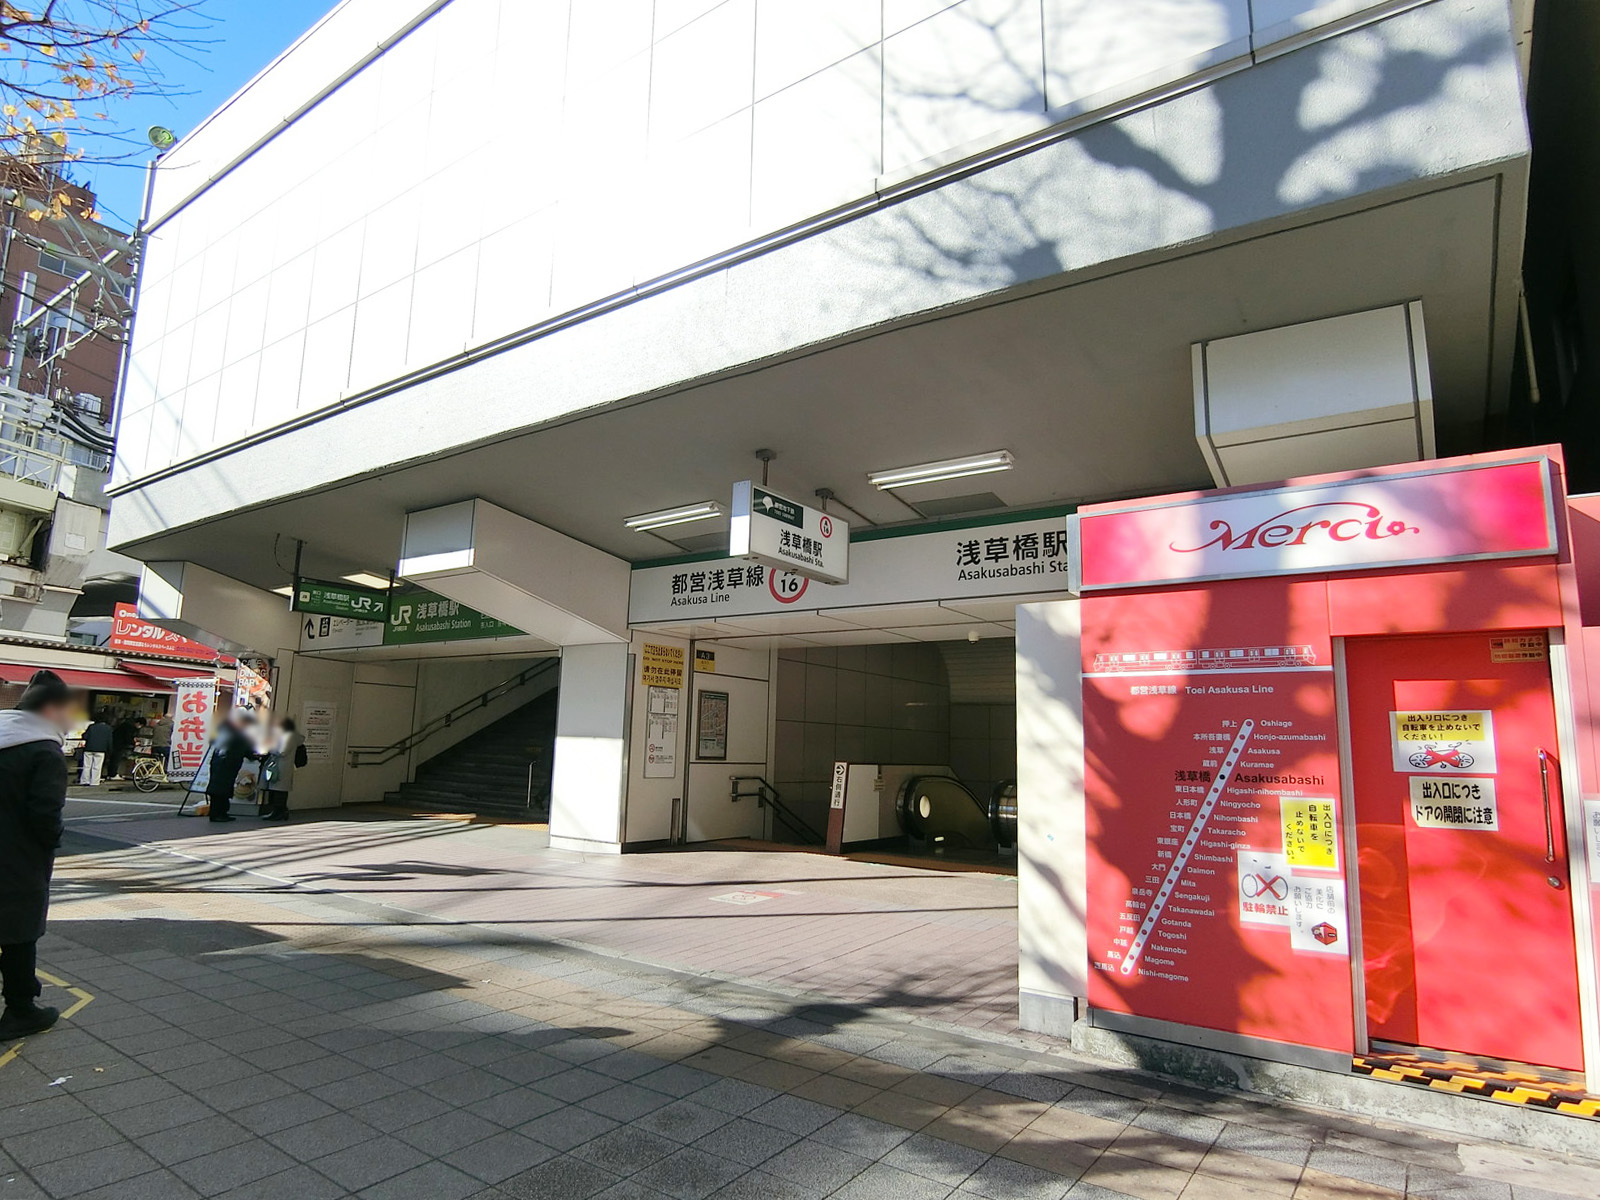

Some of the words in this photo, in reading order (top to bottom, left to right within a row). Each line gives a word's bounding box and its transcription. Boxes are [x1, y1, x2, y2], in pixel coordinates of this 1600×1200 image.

[1169, 502, 1420, 553] Merci
[780, 529, 823, 558] 浅草橋駅
[956, 530, 1067, 567] 浅草橋駅
[778, 546, 814, 565] Asakusabashi
[958, 561, 1045, 582] Asakusabashi
[671, 565, 765, 595] 都営浅草線
[780, 578, 799, 594] 16
[351, 596, 372, 610] JR
[670, 594, 708, 607] Asakusa
[711, 592, 730, 604] Line
[390, 605, 412, 625] JR
[416, 600, 460, 619] 浅草橋駅
[415, 620, 450, 632] Asakusabashi
[451, 618, 471, 629] Station
[1130, 686, 1177, 696] 都営浅草線
[1185, 686, 1205, 695] Toei
[1208, 686, 1250, 694] Asakusa
[1252, 685, 1274, 693] Line
[1406, 713, 1469, 722] 出入り口につき
[177, 690, 208, 768] お弁当
[1222, 720, 1238, 728] 押上
[1260, 719, 1292, 728] Oshiage
[1402, 723, 1481, 732] 自転車を止めないで
[1253, 733, 1326, 742] Honjo-azumabashi
[1209, 747, 1224, 755] 浅草
[1240, 761, 1274, 769] Kuramae
[1174, 770, 1211, 783] 浅草橋
[1234, 772, 1325, 786] Asakusabashi
[1175, 786, 1205, 795] 東日本橋
[1226, 787, 1303, 797] Higashi-nihombashi
[1422, 782, 1481, 800] 出入口につき
[1176, 799, 1198, 807] 人形町
[1220, 800, 1261, 810] Ningyocho
[1169, 811, 1192, 820] 日本橋
[1213, 814, 1258, 824] Nihombashi
[1415, 806, 1494, 825] ドアの開閉に注意
[1308, 804, 1319, 841] 自転車を
[1170, 824, 1185, 833] 宝町
[1207, 827, 1246, 837] Takaracho
[1295, 810, 1305, 853] 止めないで
[1322, 803, 1334, 855] 出入口につき
[1157, 837, 1179, 846] 東銀座
[1200, 840, 1251, 851] Higashi-ginza
[1285, 823, 1295, 860] ください。
[1157, 850, 1172, 859] 新橋
[1194, 853, 1233, 863] Shimbashi
[1151, 864, 1166, 872] 大門
[1187, 866, 1215, 875] Daimon
[1145, 876, 1160, 884] 三田
[1180, 879, 1197, 888] Mita
[1174, 891, 1210, 902] Sengakuji
[1168, 905, 1215, 917] Takanawadai
[1242, 901, 1289, 916] 駐輪禁止
[1119, 913, 1141, 922] 五反田
[1161, 918, 1192, 928] Gotanda
[1158, 930, 1187, 940] Togoshi
[1151, 943, 1187, 955] Nakanobu
[1144, 955, 1175, 966] Magome
[1138, 968, 1189, 982] Nishi-magome
